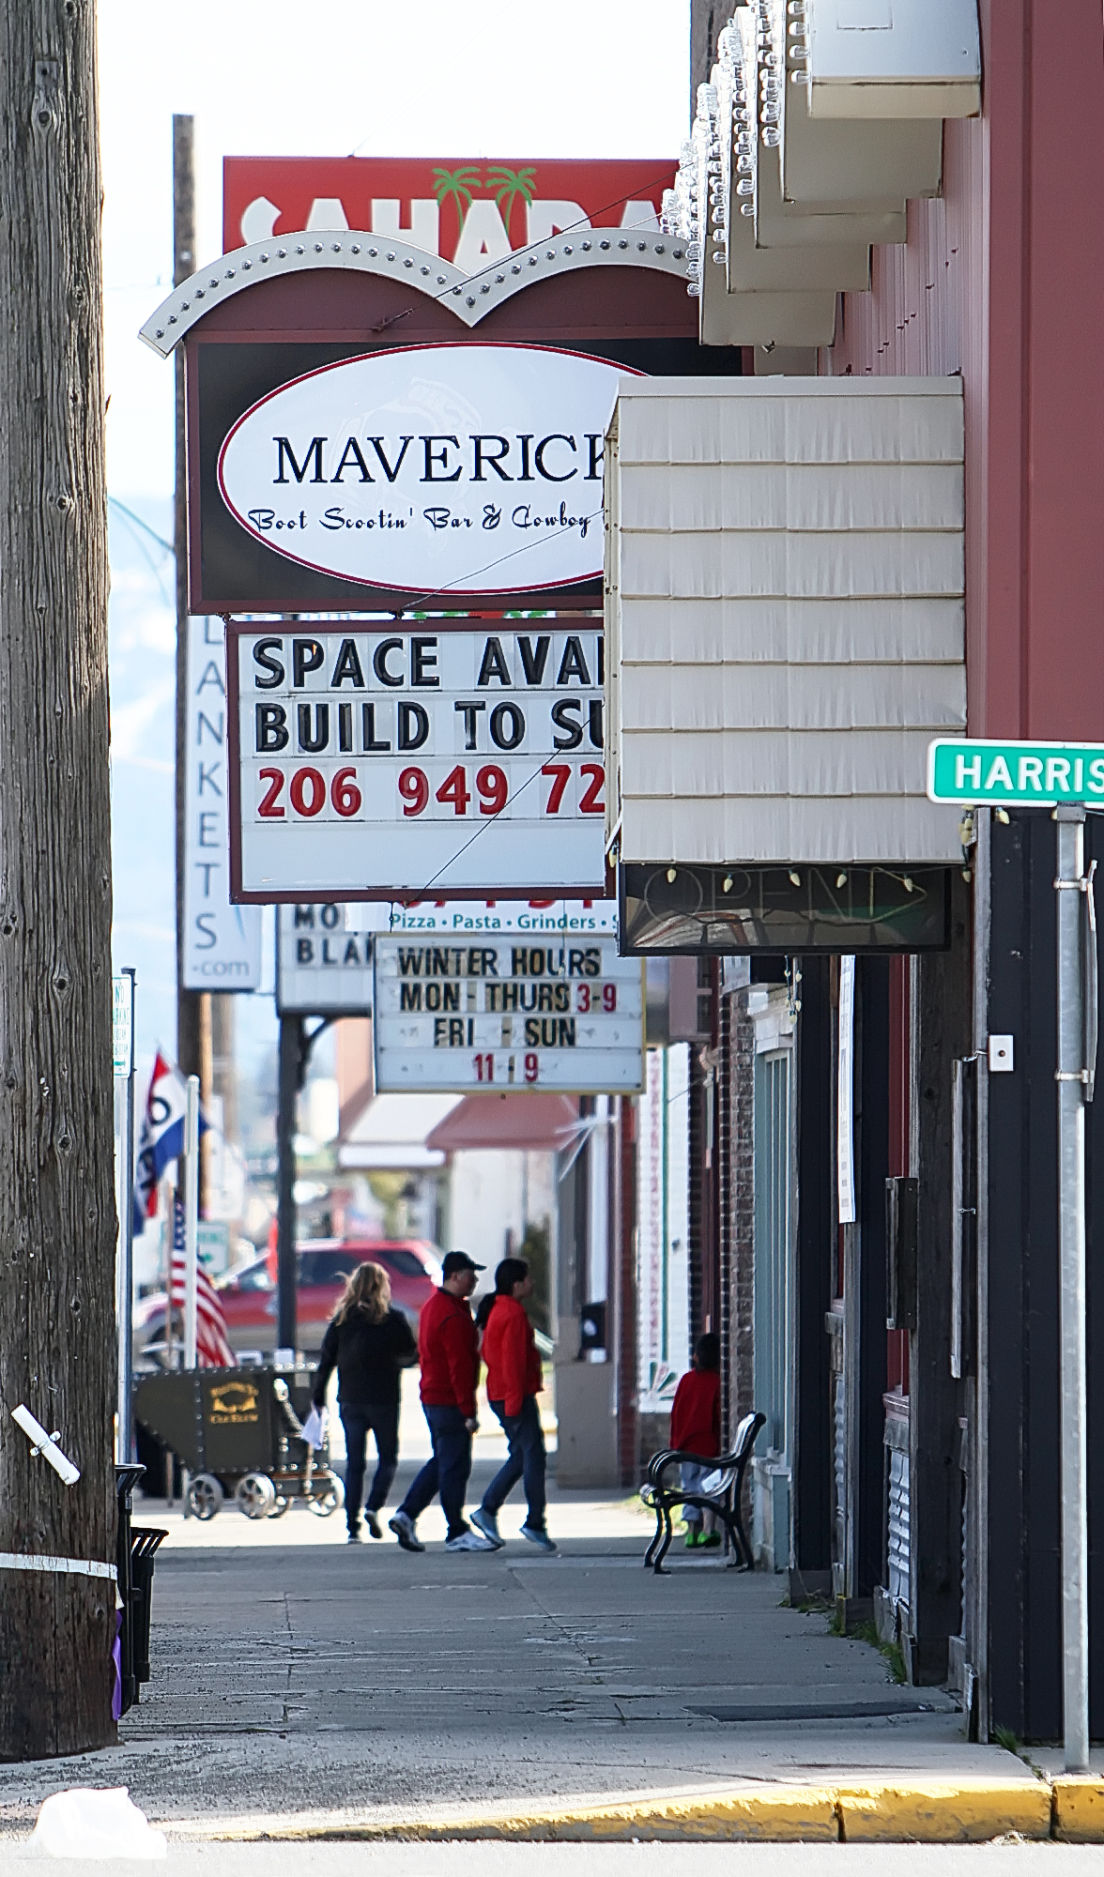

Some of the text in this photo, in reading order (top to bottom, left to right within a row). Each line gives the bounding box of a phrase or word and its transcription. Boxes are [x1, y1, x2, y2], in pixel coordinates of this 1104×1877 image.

[248, 501, 591, 538] Boot Scootin' Bar & Cowboy
[252, 636, 440, 689] SPACE
[254, 700, 430, 752] BUILD
[454, 700, 526, 750] TO
[257, 763, 606, 817] 206 949 72
[955, 754, 1104, 794] HARRIS
[391, 913, 436, 929] Pizza
[452, 913, 500, 929] Pasta
[517, 912, 596, 929] Grinders
[399, 947, 600, 976] WINTER HOURS
[401, 984, 460, 1012] MON
[486, 983, 570, 1012] THURS
[577, 983, 616, 1013] 3-9
[435, 1018, 474, 1046] FRI
[525, 1018, 576, 1046] SUN
[474, 1054, 494, 1082] 11
[525, 1053, 539, 1082] 9
